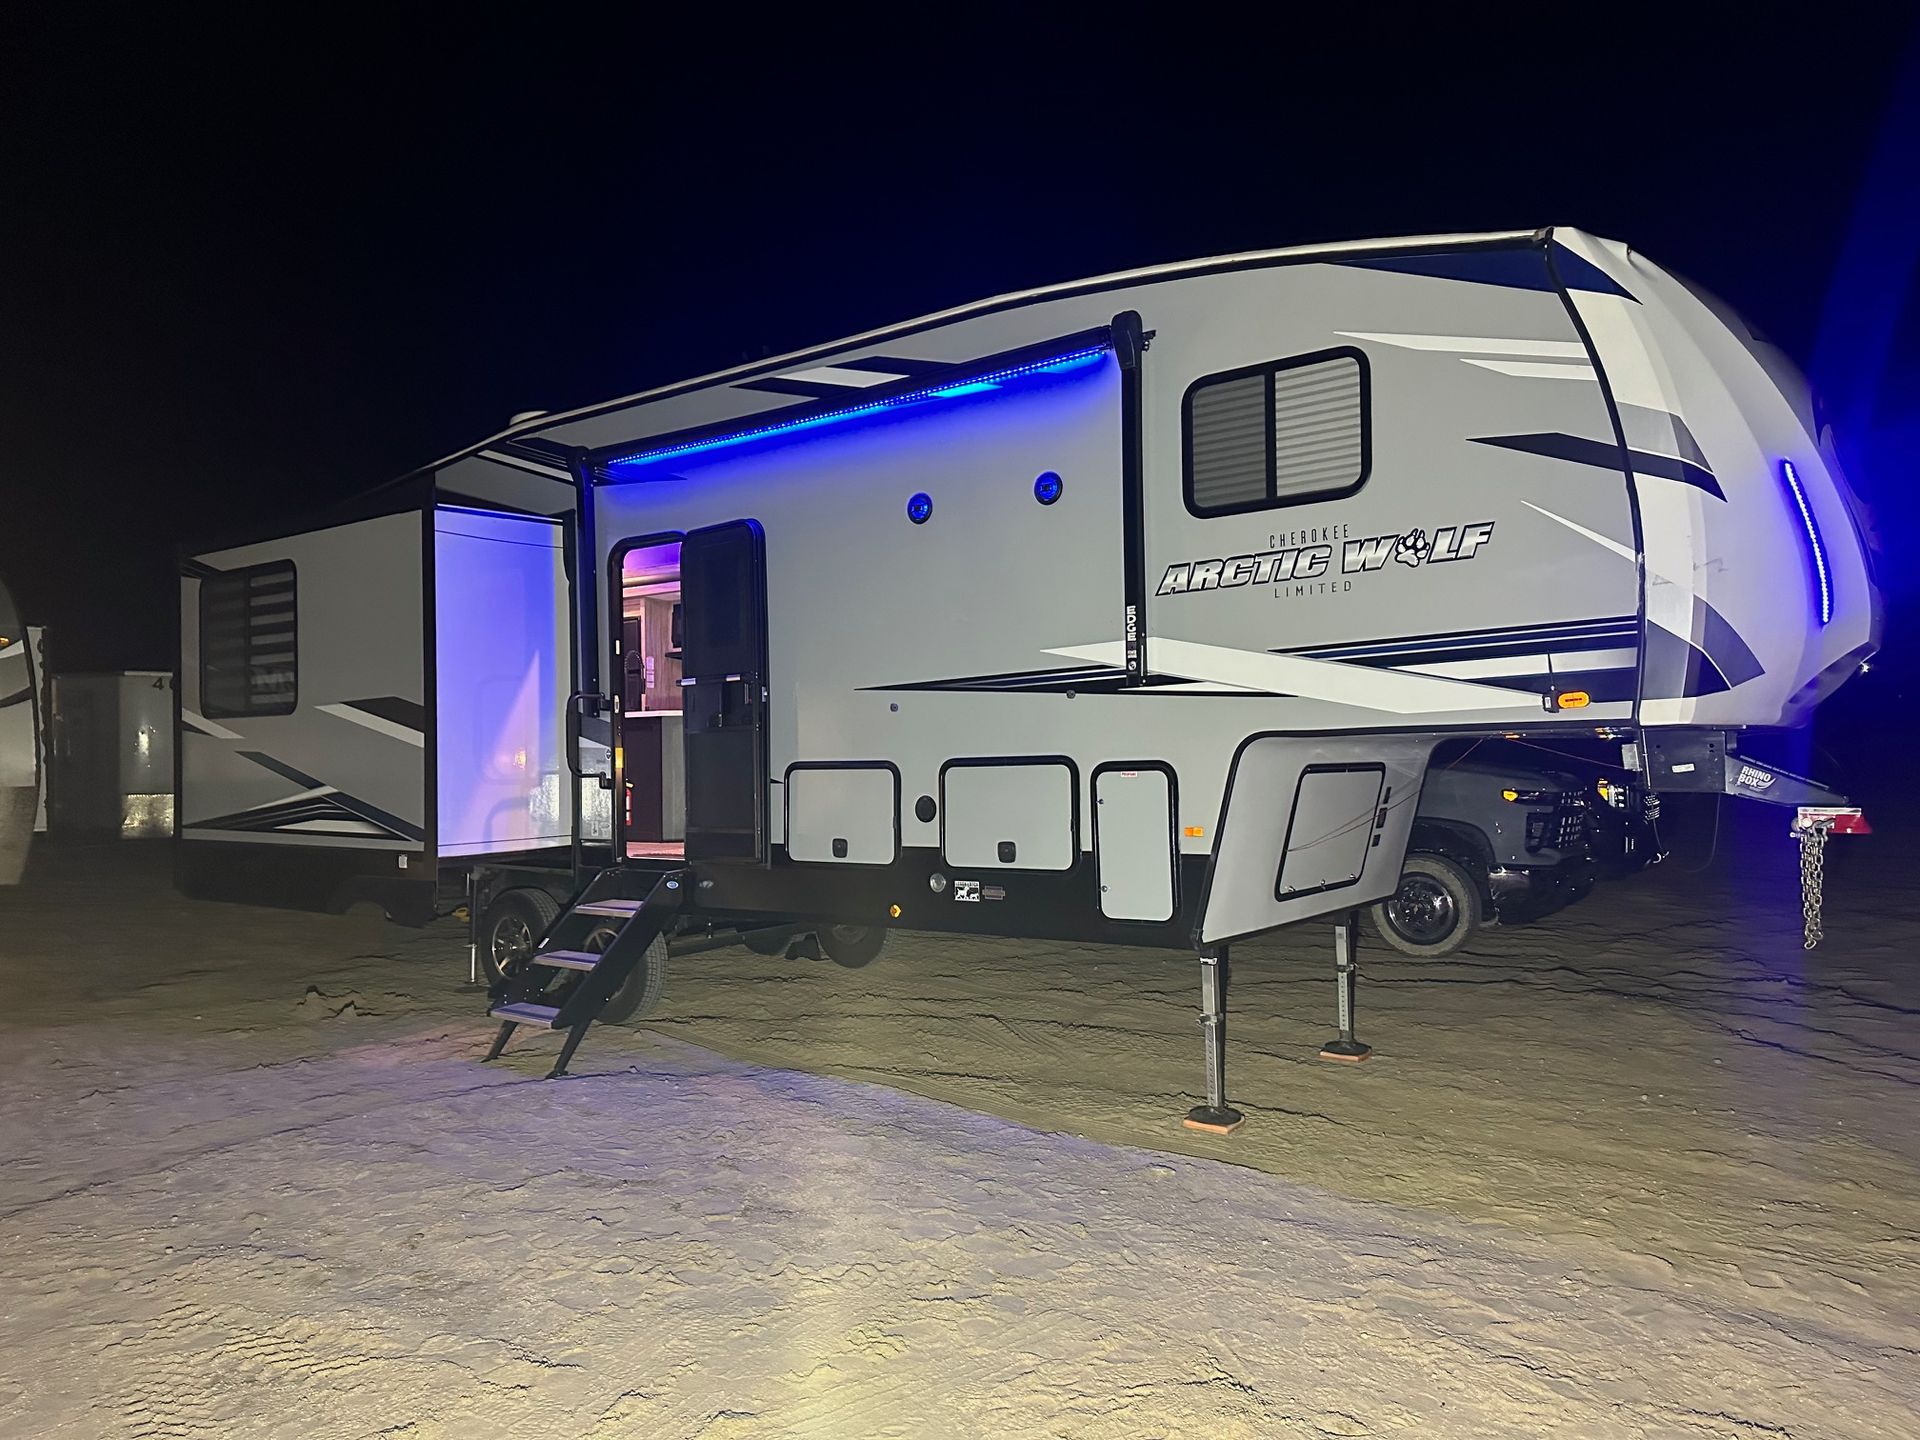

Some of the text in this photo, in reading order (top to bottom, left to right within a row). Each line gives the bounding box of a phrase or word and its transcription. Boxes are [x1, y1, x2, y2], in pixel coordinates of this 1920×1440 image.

[1269, 523, 1350, 549] CHEROKEE
[1155, 543, 1333, 597] ARCTIC
[1274, 580, 1353, 599] LIMITED
[1126, 605, 1137, 641] EDGE
[1738, 773, 1760, 787] BOX
[1741, 765, 1771, 782] RHINO
